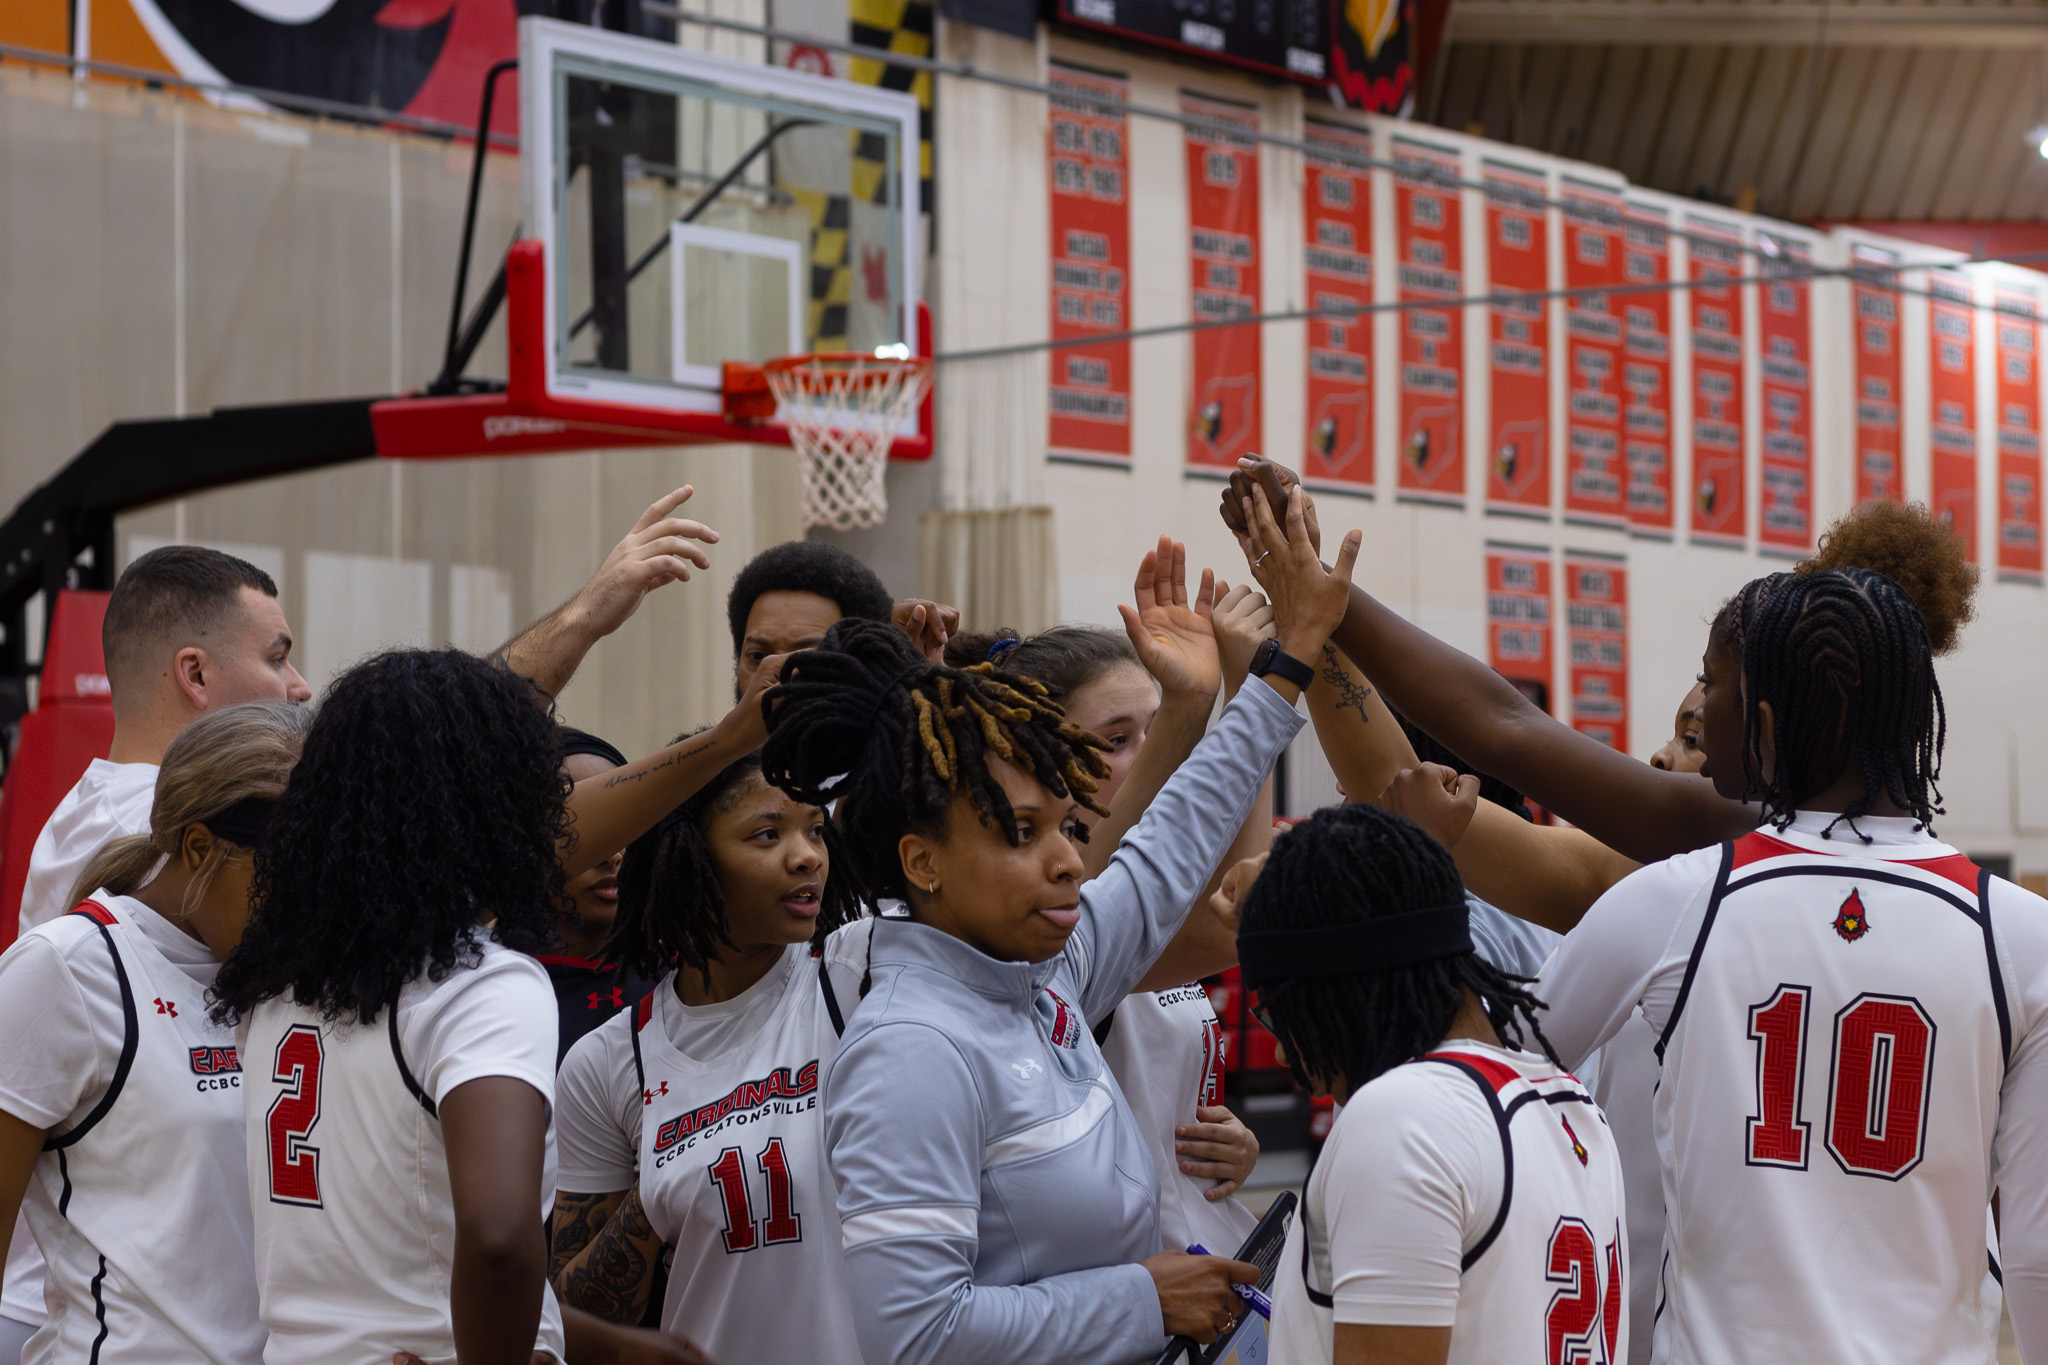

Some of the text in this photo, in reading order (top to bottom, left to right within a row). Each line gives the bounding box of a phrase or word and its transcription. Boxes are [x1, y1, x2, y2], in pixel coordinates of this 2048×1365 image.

[1158, 991, 1184, 1007] CCBC
[197, 1076, 240, 1092] CCBC
[265, 1023, 325, 1209] 2
[653, 1059, 819, 1154] CARDINALS
[1745, 983, 1937, 1183] 10
[656, 1096, 817, 1169] CCBC CATONSVILLE
[708, 1136, 802, 1254] 11
